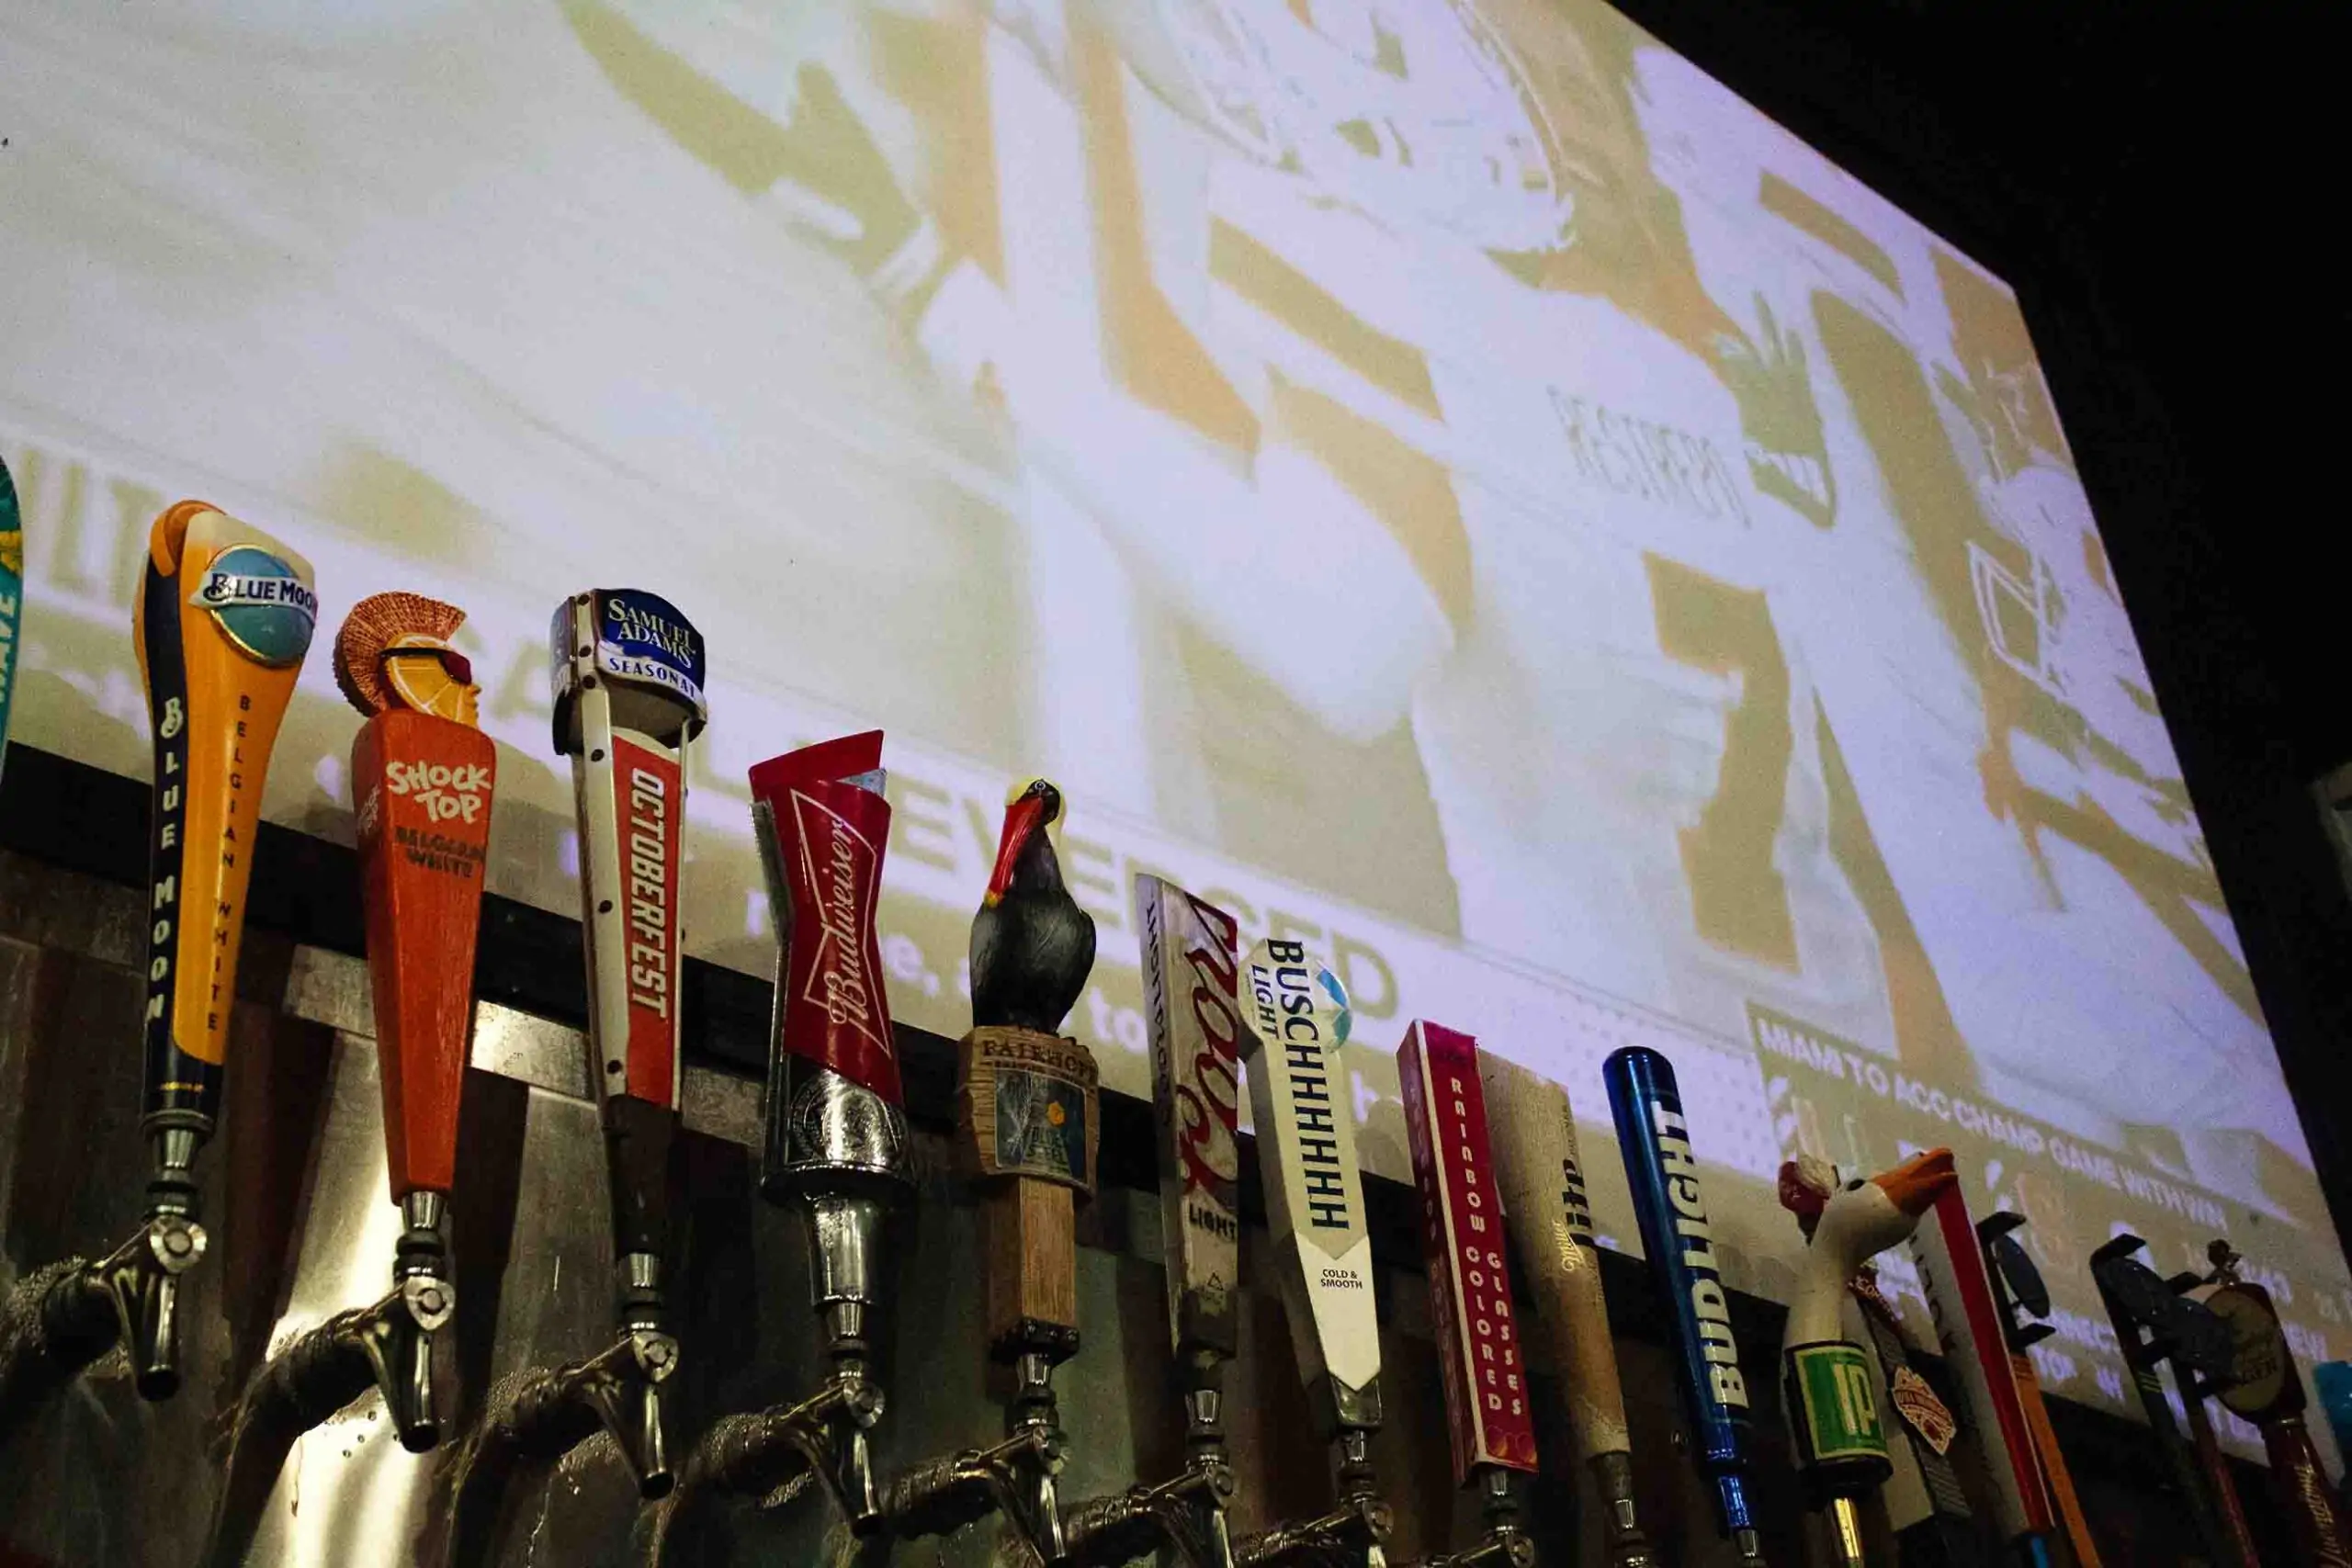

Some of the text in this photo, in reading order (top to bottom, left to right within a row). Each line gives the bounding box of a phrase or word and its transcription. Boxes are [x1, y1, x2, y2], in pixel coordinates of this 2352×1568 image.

[278, 580, 317, 612] MOO
[608, 598, 696, 655] SAMUEL
[617, 621, 693, 670] ADAMS
[386, 760, 492, 795] SHOCK
[413, 789, 482, 825] TOP
[208, 694, 251, 1031] BELGIAN WHITE
[630, 767, 669, 1019] OCTOBERFEST
[821, 818, 869, 1024] Budweiser
[1252, 964, 1280, 1041] LIGHT
[1267, 937, 1350, 1231] BUSCHHHHHH
[1843, 1052, 1890, 1100] TO
[1450, 1077, 1487, 1235] RAINBOW
[1189, 1202, 1237, 1241] LIGHT
[1650, 1099, 1750, 1410] BUD LIGHT
[1320, 1278, 1363, 1290] SMOOTH
[1322, 1269, 1358, 1280] COLD &
[1465, 1246, 1503, 1413] COLORED
[1487, 1251, 1523, 1416] GLASSES
